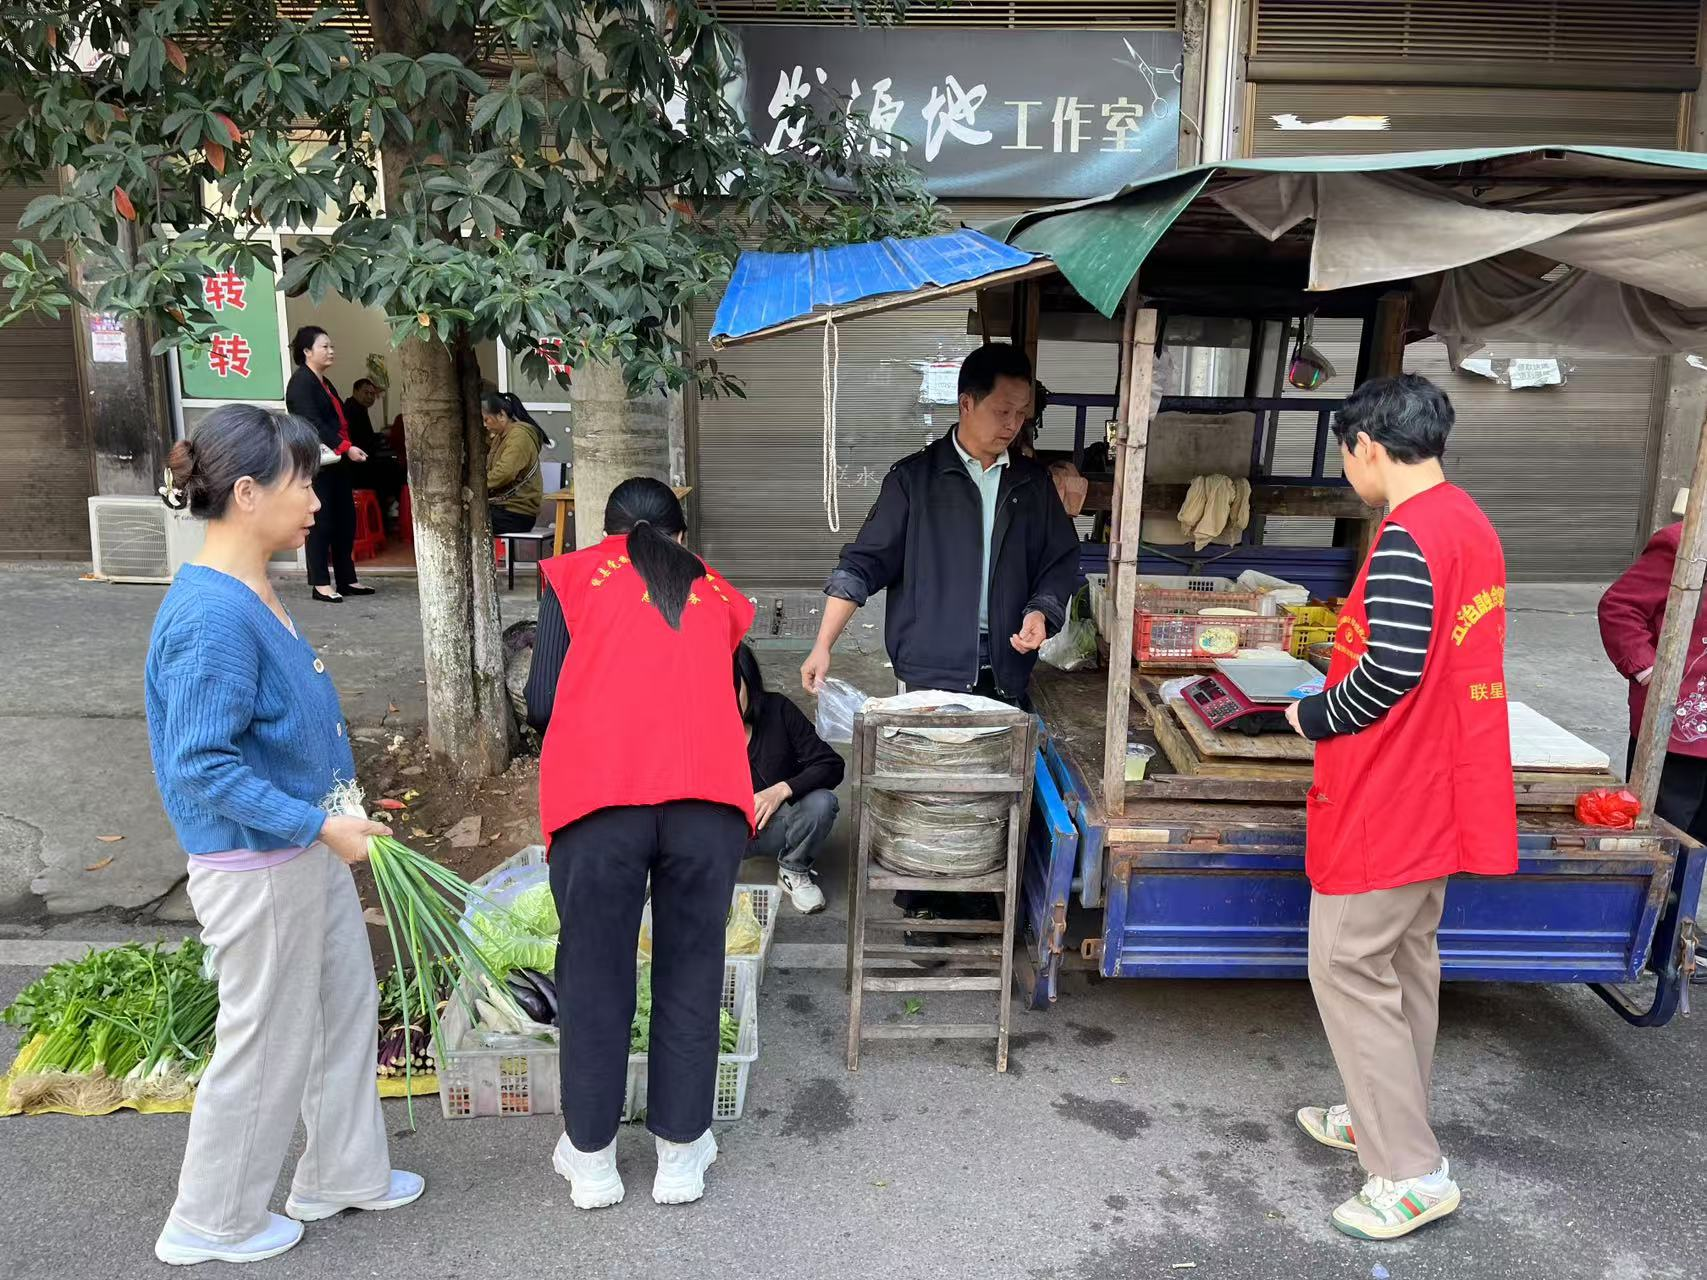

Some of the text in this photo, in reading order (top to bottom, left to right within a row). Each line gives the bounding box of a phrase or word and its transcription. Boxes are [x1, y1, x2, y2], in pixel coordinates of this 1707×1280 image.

[1001, 96, 1143, 153] 工作室
[204, 265, 247, 311] 转
[209, 333, 251, 377] 转
[1470, 681, 1505, 701] 联星
